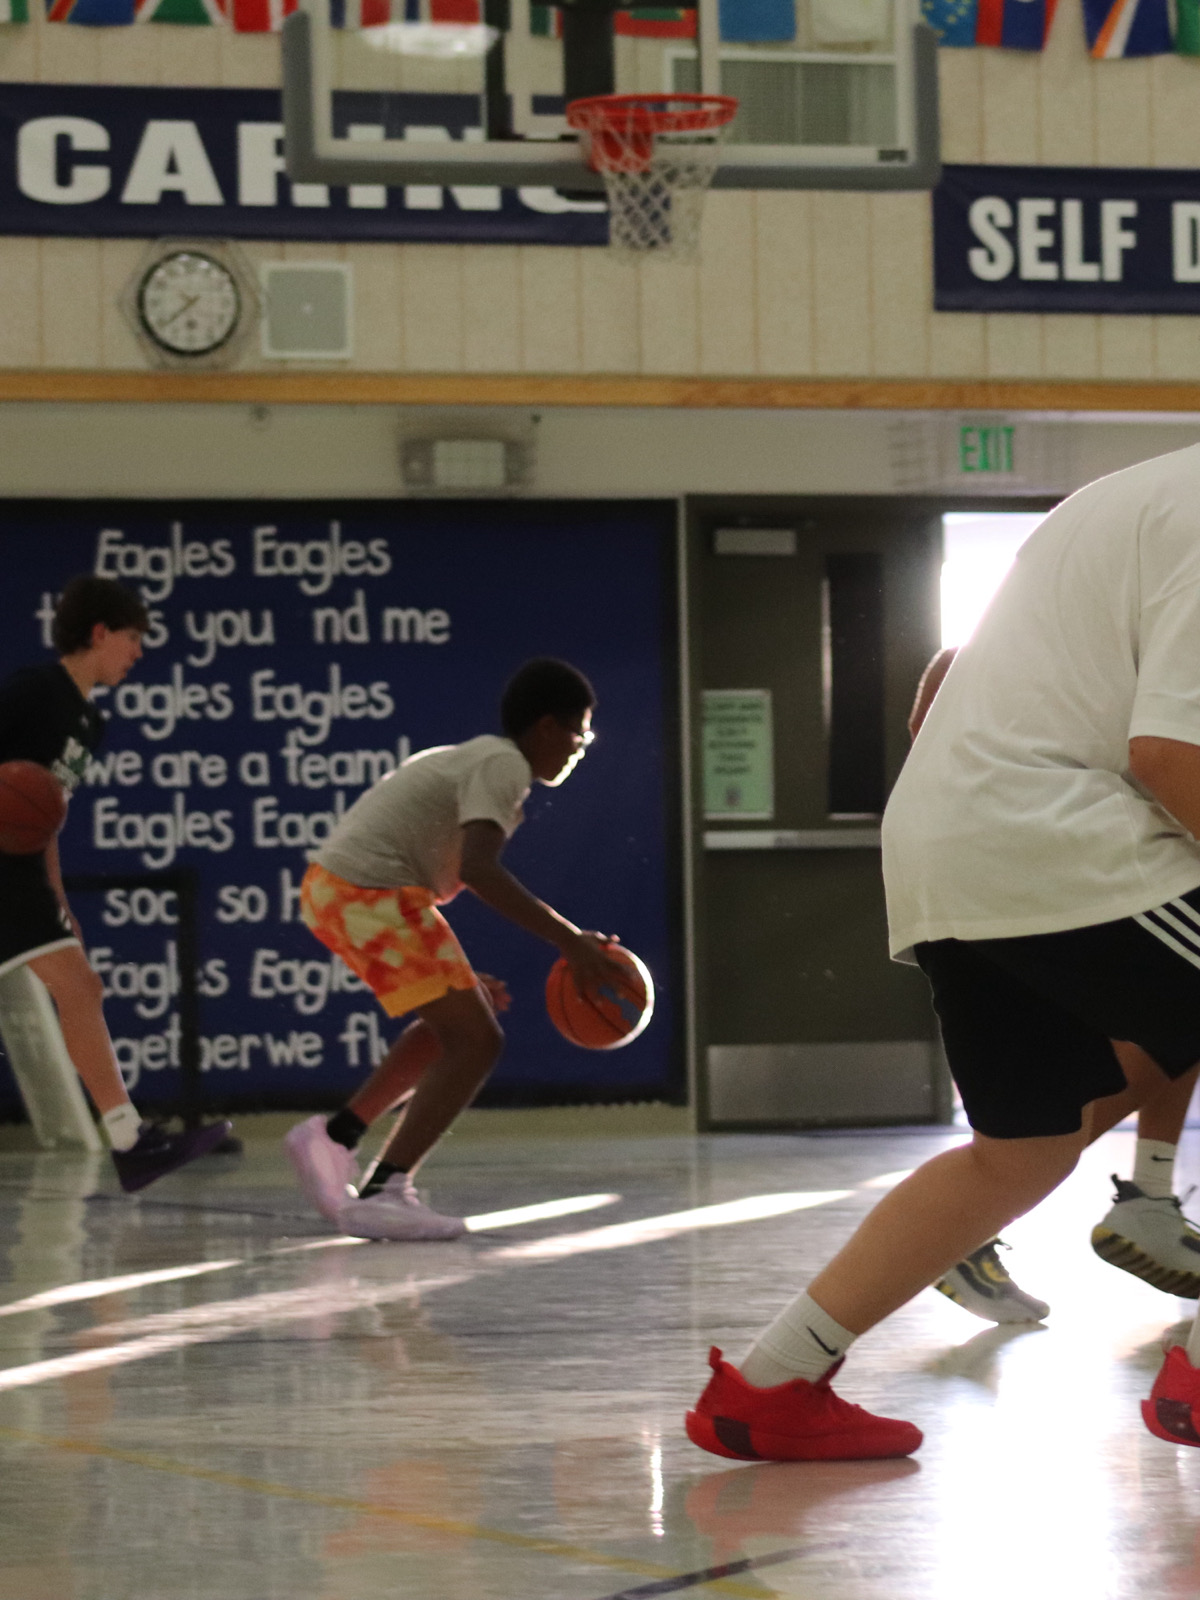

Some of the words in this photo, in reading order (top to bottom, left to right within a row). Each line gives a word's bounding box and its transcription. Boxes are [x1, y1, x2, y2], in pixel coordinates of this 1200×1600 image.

[967, 196, 1138, 282] SELF
[960, 426, 1014, 471] EXIT
[94, 521, 236, 602] Eagles
[253, 519, 392, 596] Eagles
[184, 608, 275, 668] you
[382, 606, 451, 644] me
[251, 663, 396, 746] Eagles
[84, 750, 143, 787] we
[151, 750, 229, 788] are
[239, 751, 271, 787] a
[93, 791, 235, 869] Eagles
[215, 885, 268, 923] so
[89, 940, 230, 1019] Eagls
[250, 948, 375, 1016] Eagle
[263, 1030, 324, 1068] we
